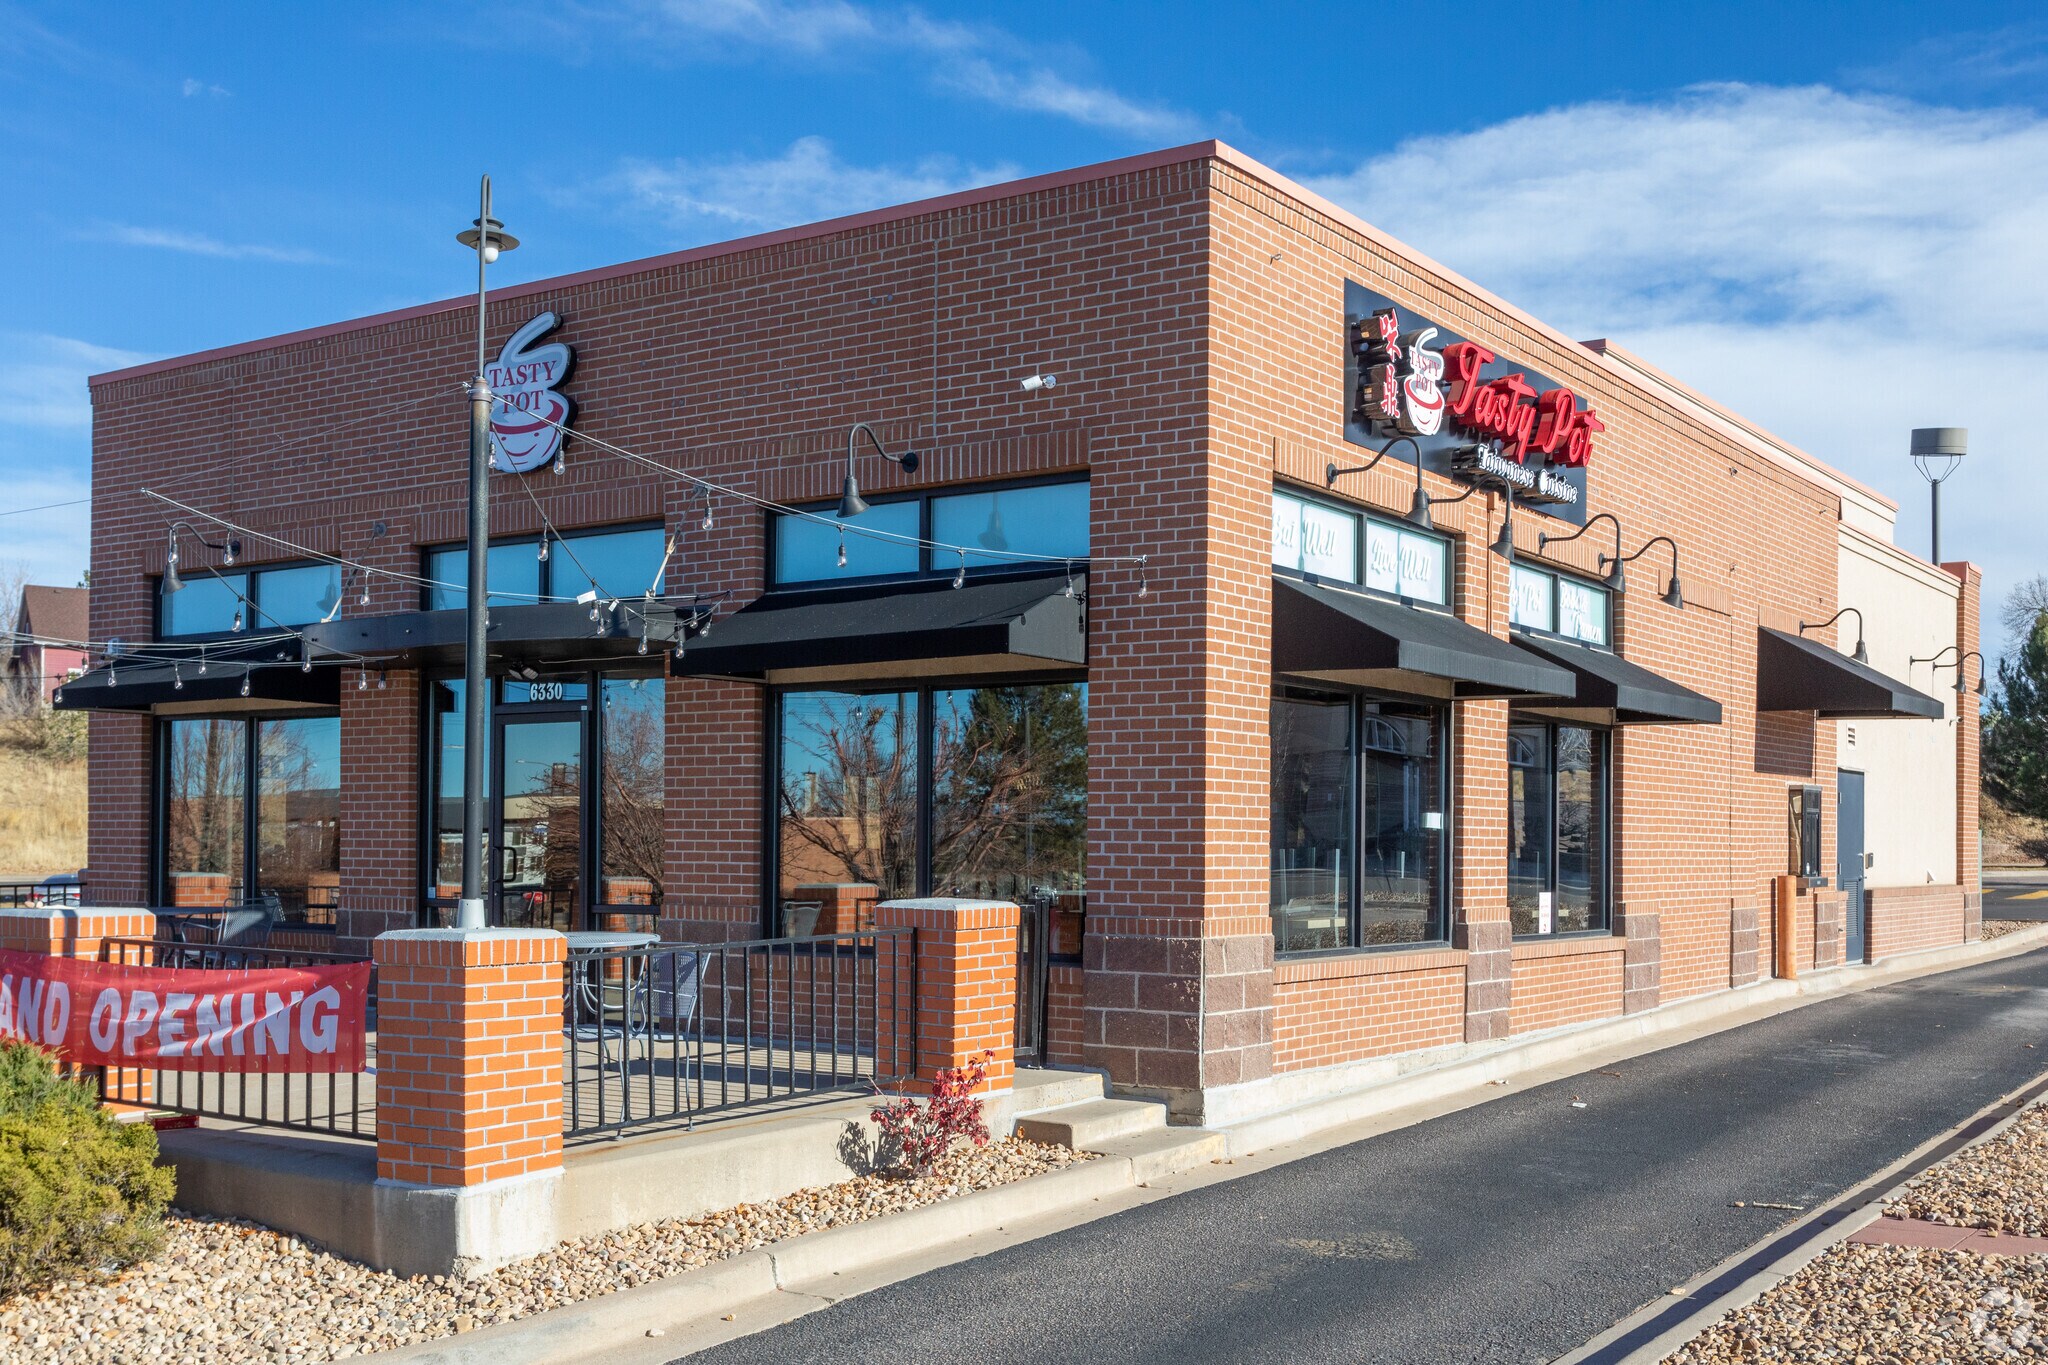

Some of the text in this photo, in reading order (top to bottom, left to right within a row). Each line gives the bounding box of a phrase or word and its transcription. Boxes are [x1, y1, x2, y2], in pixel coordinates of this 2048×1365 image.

[489, 360, 557, 388] TASTY
[1410, 350, 1441, 378] TASTY
[1415, 372, 1434, 396] POT
[502, 389, 543, 414] POT
[1448, 342, 1605, 468] Tasty Pot
[1478, 443, 1578, 503] Taiwanese Cuisine
[1304, 518, 1338, 556] Well
[1372, 537, 1431, 581] Live Well
[531, 683, 562, 701] 6330
[89, 985, 340, 1057] OPENING
